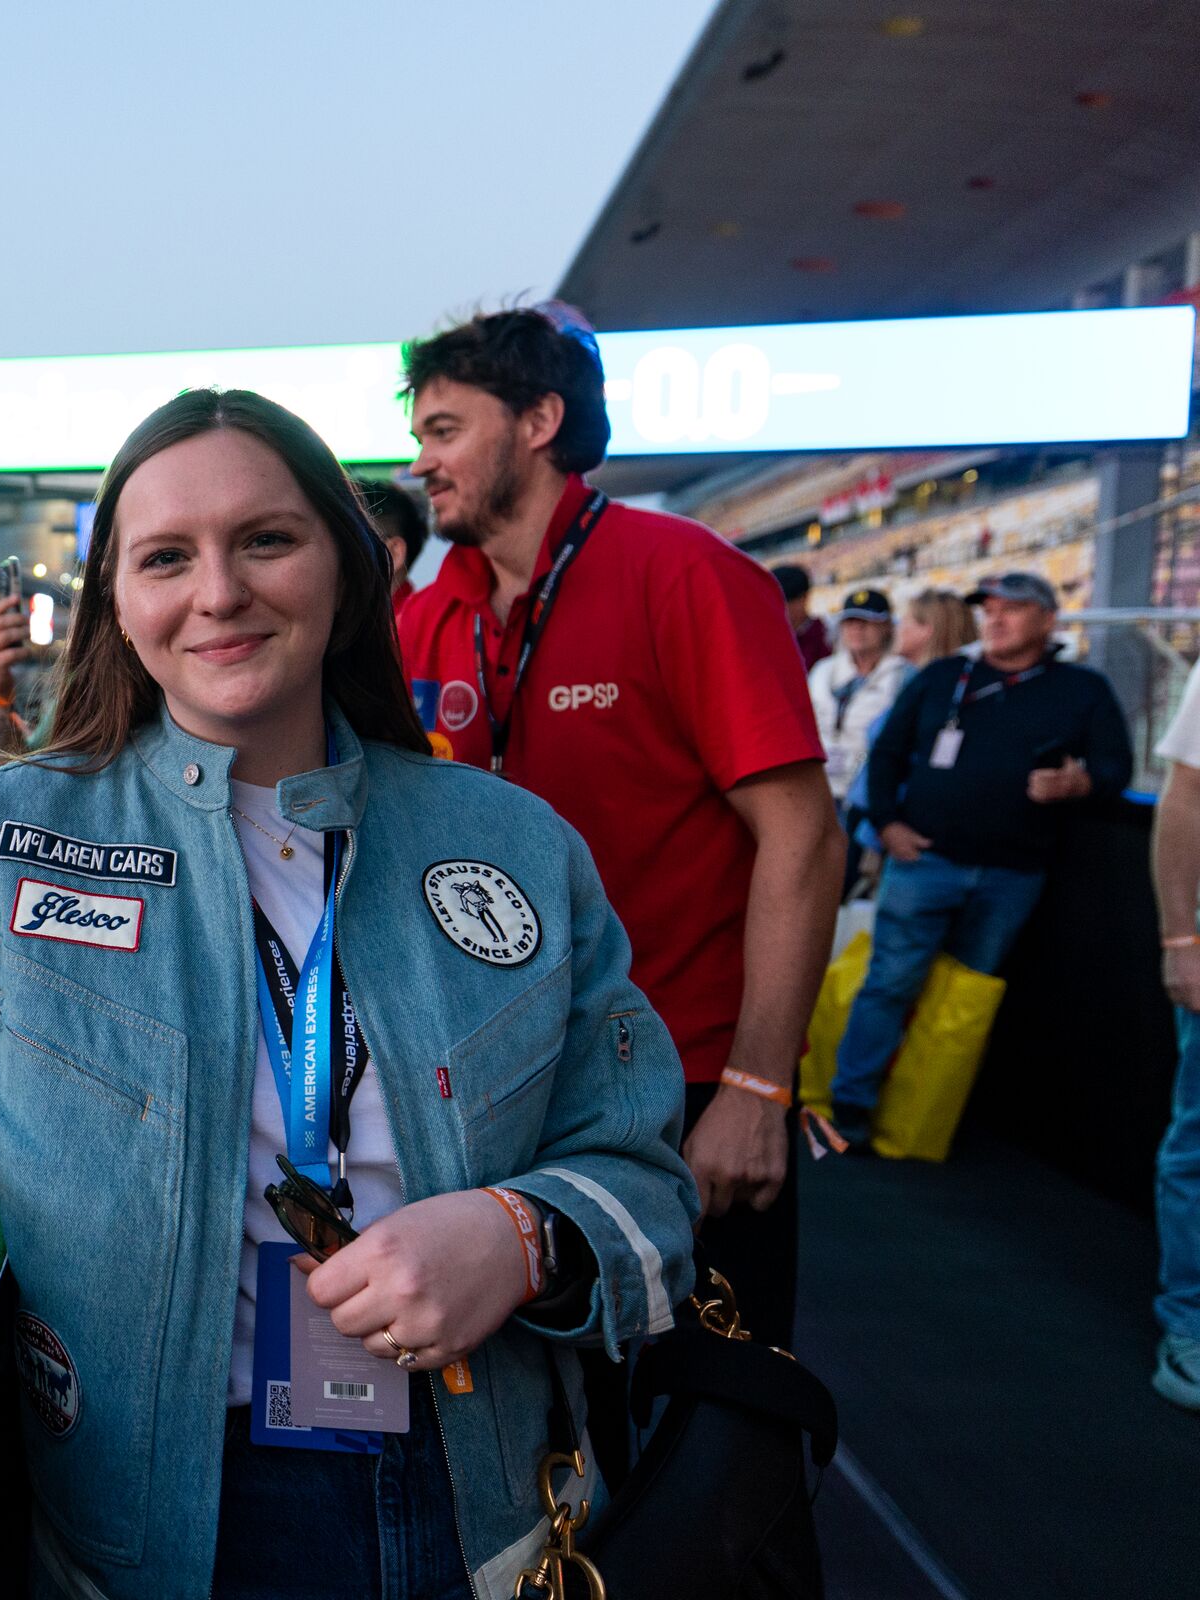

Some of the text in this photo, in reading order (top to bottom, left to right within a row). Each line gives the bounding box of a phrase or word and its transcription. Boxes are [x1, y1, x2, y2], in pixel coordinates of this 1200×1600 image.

[548, 682, 619, 712] GPSP
[109, 850, 164, 876] CARS
[428, 865, 493, 890] STRAUSS
[430, 892, 454, 923] LEVI
[461, 923, 534, 959] SINCE 1873
[304, 966, 320, 1122] AMERICAN EXPRESS
